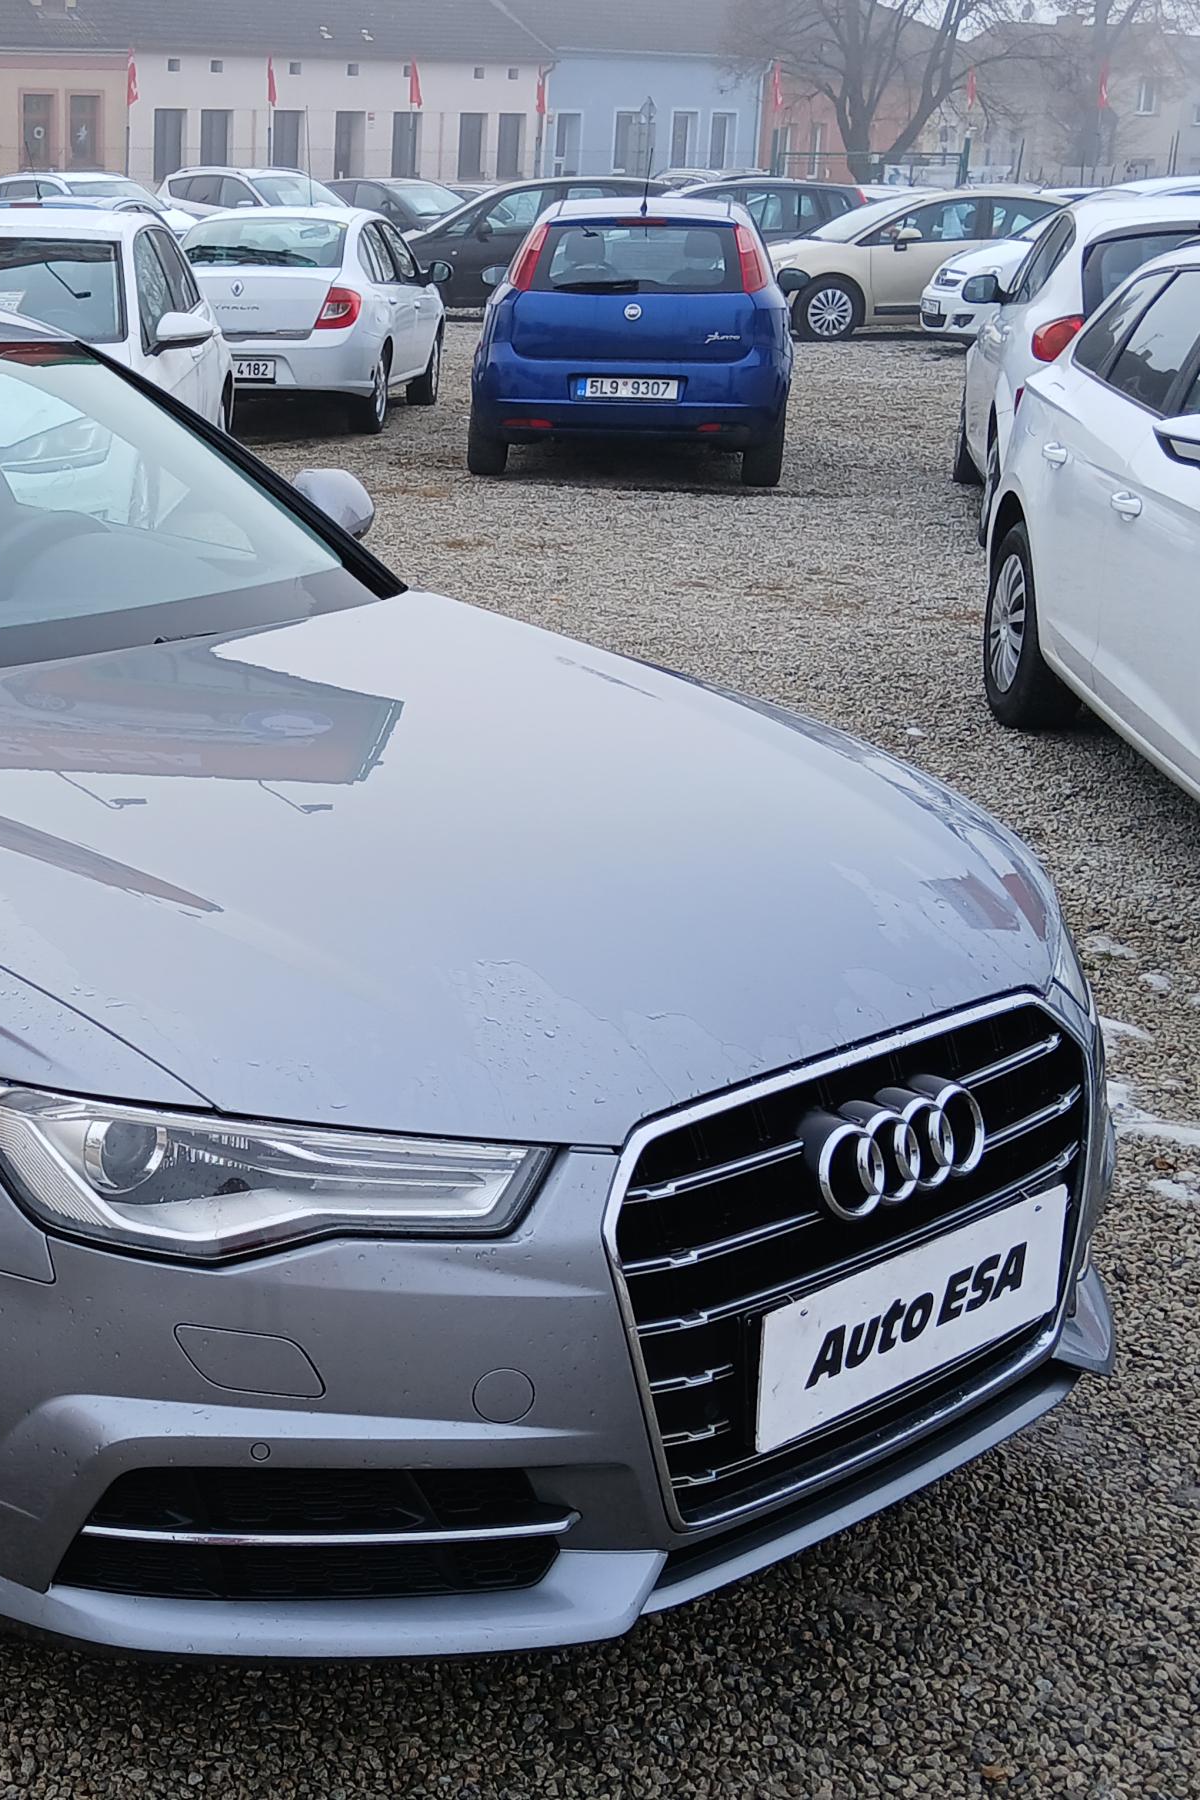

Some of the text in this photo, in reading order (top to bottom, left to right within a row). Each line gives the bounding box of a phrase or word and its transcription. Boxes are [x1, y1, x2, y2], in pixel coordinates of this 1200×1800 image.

[237, 362, 269, 376] 4182
[589, 379, 671, 396] 5L9 9307
[804, 1241, 1028, 1390] Auto ESA
